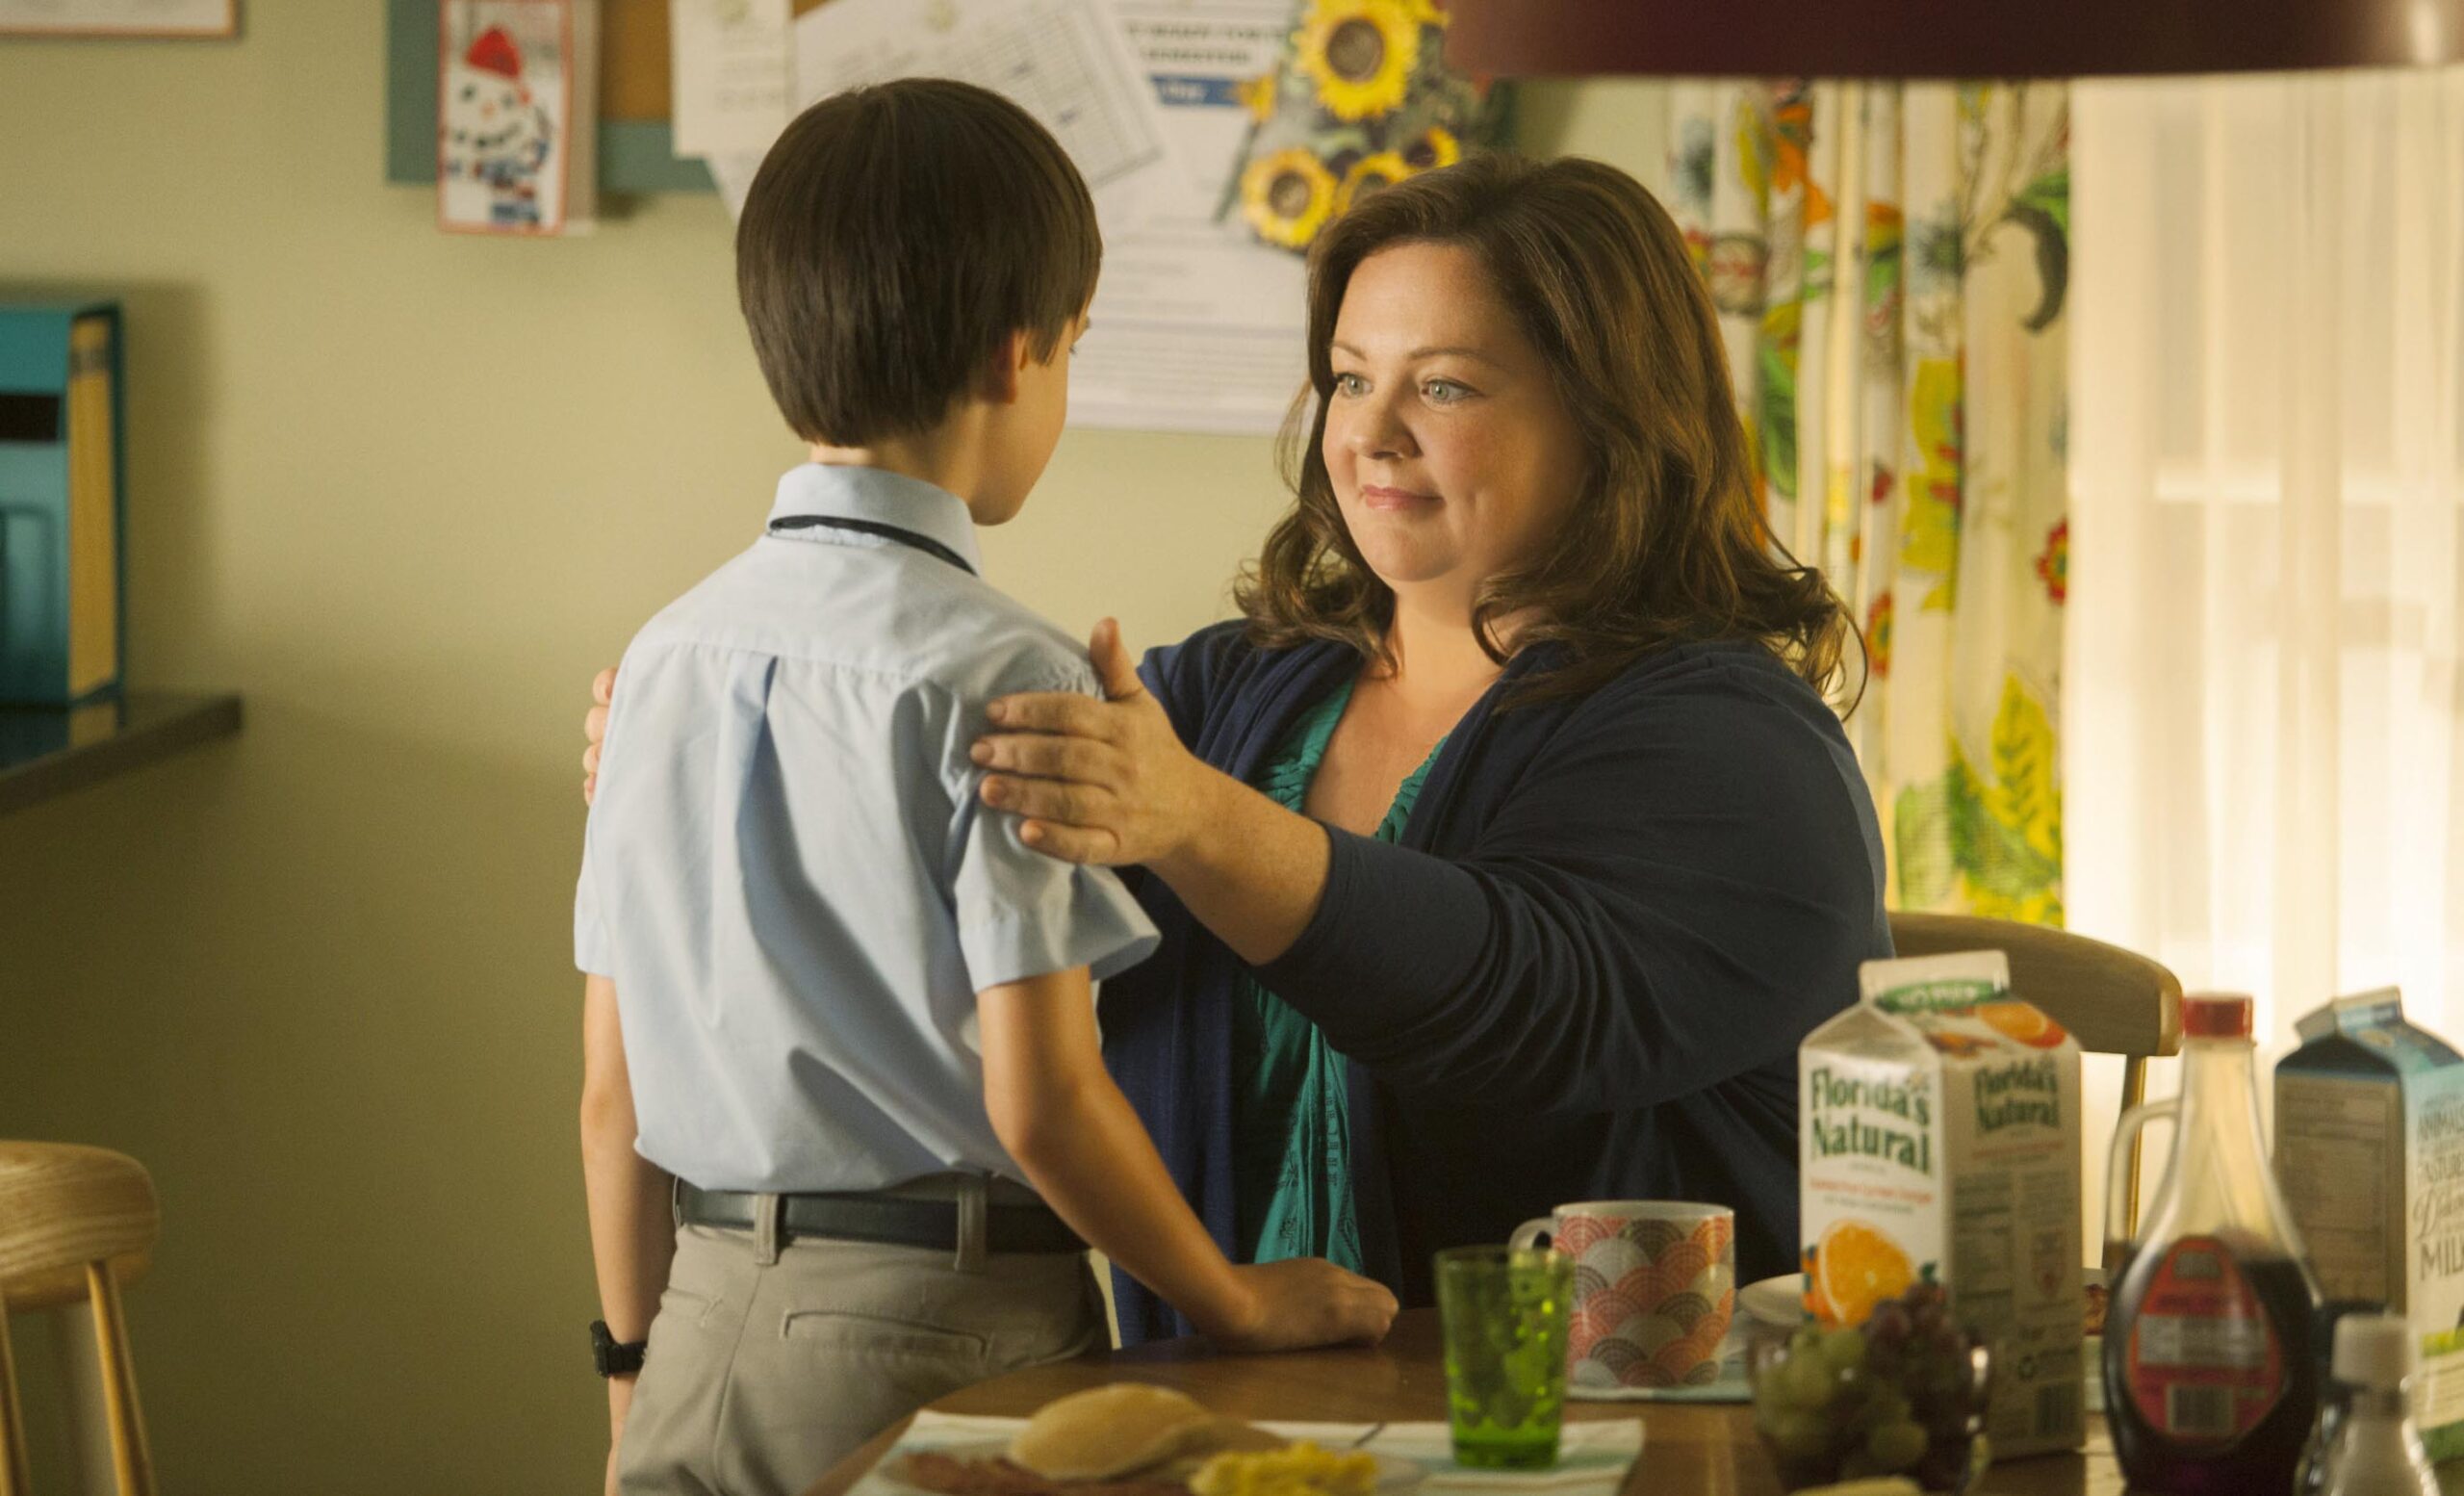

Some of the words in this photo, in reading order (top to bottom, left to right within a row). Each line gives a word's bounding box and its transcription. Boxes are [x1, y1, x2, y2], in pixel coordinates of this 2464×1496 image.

[1810, 1067, 1931, 1127] Florida's
[1974, 1096, 2061, 1137] Natural
[1810, 1114, 1931, 1175] Natural
